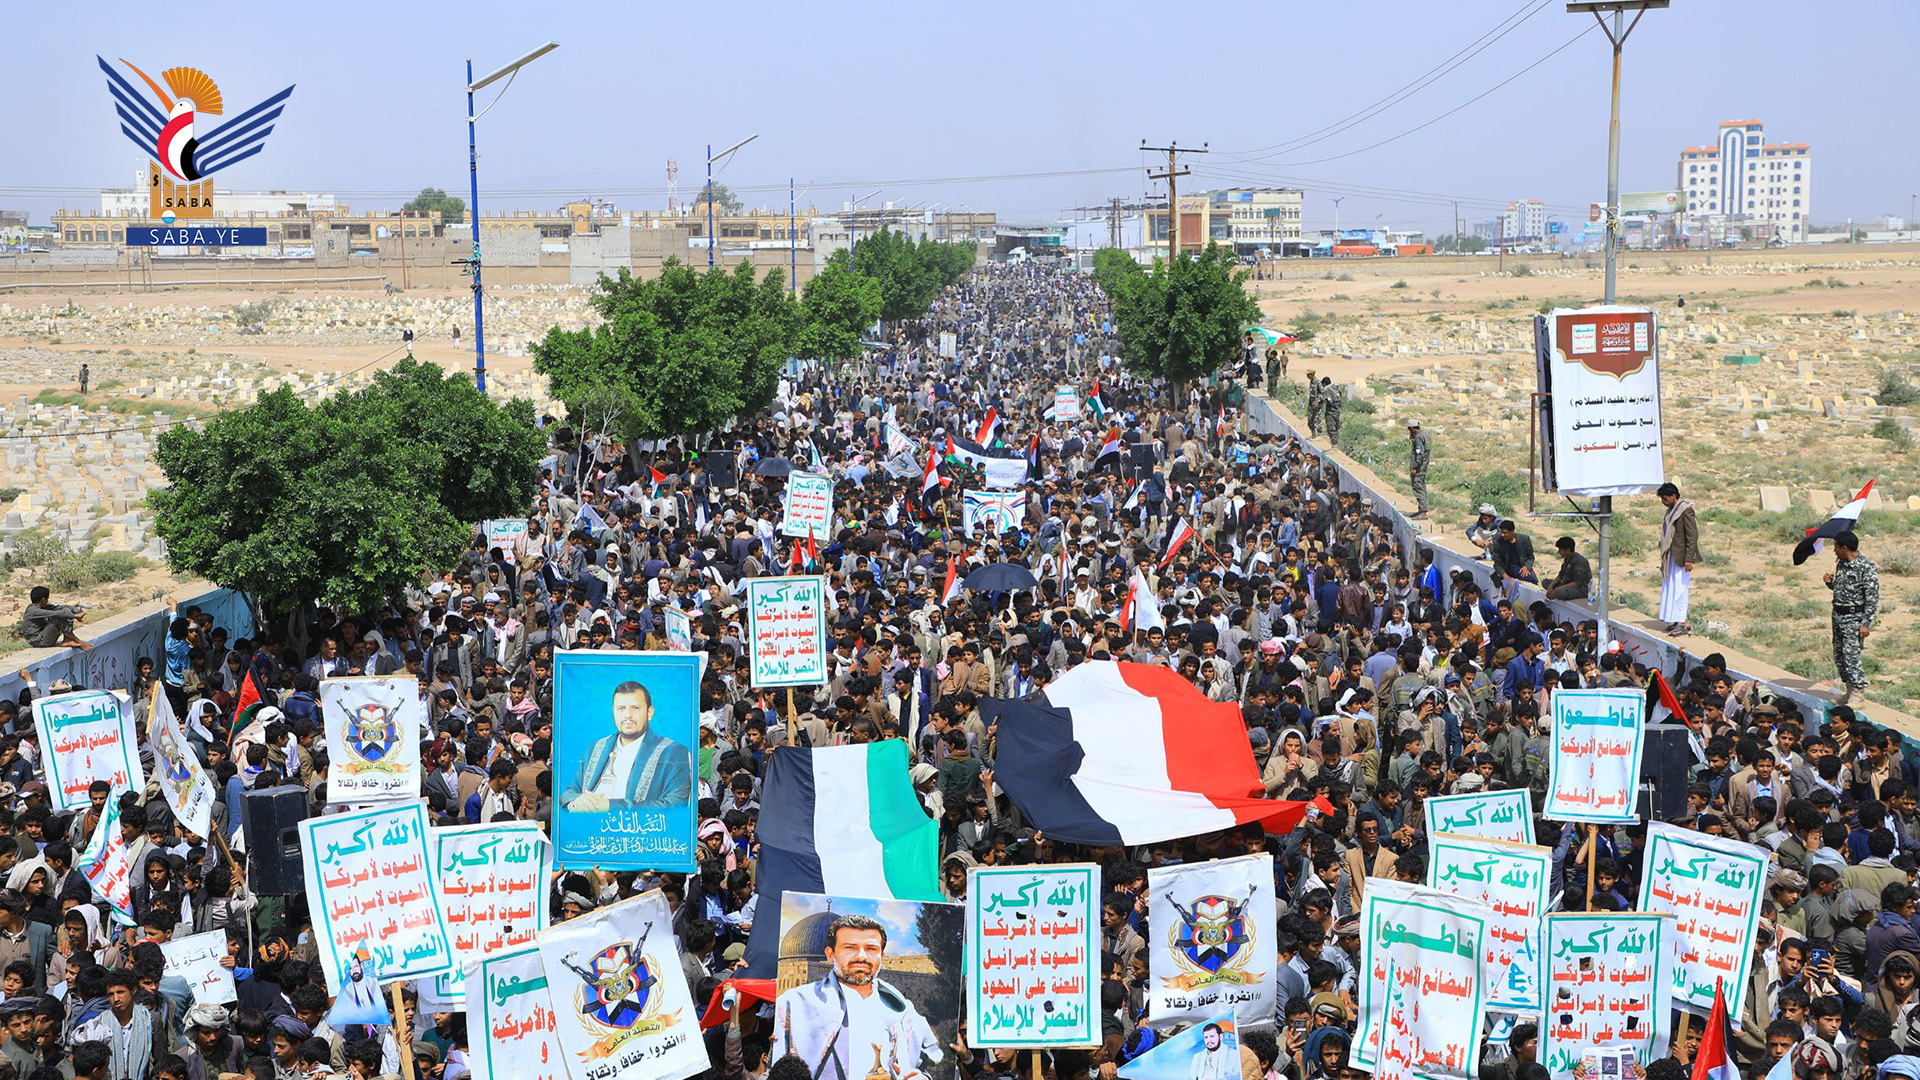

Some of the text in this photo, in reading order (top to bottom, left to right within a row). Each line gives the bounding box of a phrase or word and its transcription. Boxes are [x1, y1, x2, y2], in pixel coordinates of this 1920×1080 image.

[756, 582, 817, 609] الله أكبر
[793, 658, 819, 678] النصر
[47, 701, 117, 733] قاطعوا
[1560, 704, 1635, 730] قاطعوا
[54, 729, 120, 756] البضائع الأمريكية
[1560, 735, 1632, 759] البضائع الأمريكية
[86, 755, 91, 770] و
[1589, 762, 1595, 779] و
[1555, 784, 1630, 810] الإسرائيلية
[1437, 800, 1522, 833] الله أكبر
[320, 818, 419, 866] الله أكبر
[443, 834, 540, 877] الله أكبر
[323, 853, 423, 889] الموت لأمريكا
[1438, 854, 1538, 890] الله أكبر
[1655, 852, 1755, 891] الله أكبر
[443, 872, 537, 898] الموت لأمريكا
[983, 875, 1085, 917] الله أكبر
[1652, 878, 1749, 919] الموت لأمريكا
[330, 882, 429, 922] الموت لإسرائيل
[498, 901, 536, 922] الموت
[1492, 899, 1535, 918] الموت
[335, 908, 436, 948] اللعنة على اليهود
[983, 913, 1084, 941] الموت لأمريكا
[1376, 912, 1474, 960] قاطعوا
[1616, 927, 1655, 954] الله
[1699, 921, 1744, 946] الموت
[400, 931, 443, 969] النصر
[483, 932, 505, 954] على
[1552, 922, 1616, 962] أكبر
[1680, 945, 1700, 964] على
[983, 946, 1084, 971] الموت لإسرائيل
[1704, 950, 1739, 973] اللعنة
[1422, 967, 1473, 1002] البضائع
[1552, 960, 1606, 987] لأمريكا
[1609, 964, 1652, 987] الموت
[983, 976, 1085, 1000] اللعنة على اليهود
[492, 1003, 546, 1044] الأمريكية
[983, 1000, 1084, 1037] النصر للإسلام
[1592, 1022, 1614, 1045] على
[541, 1041, 548, 1065] و
